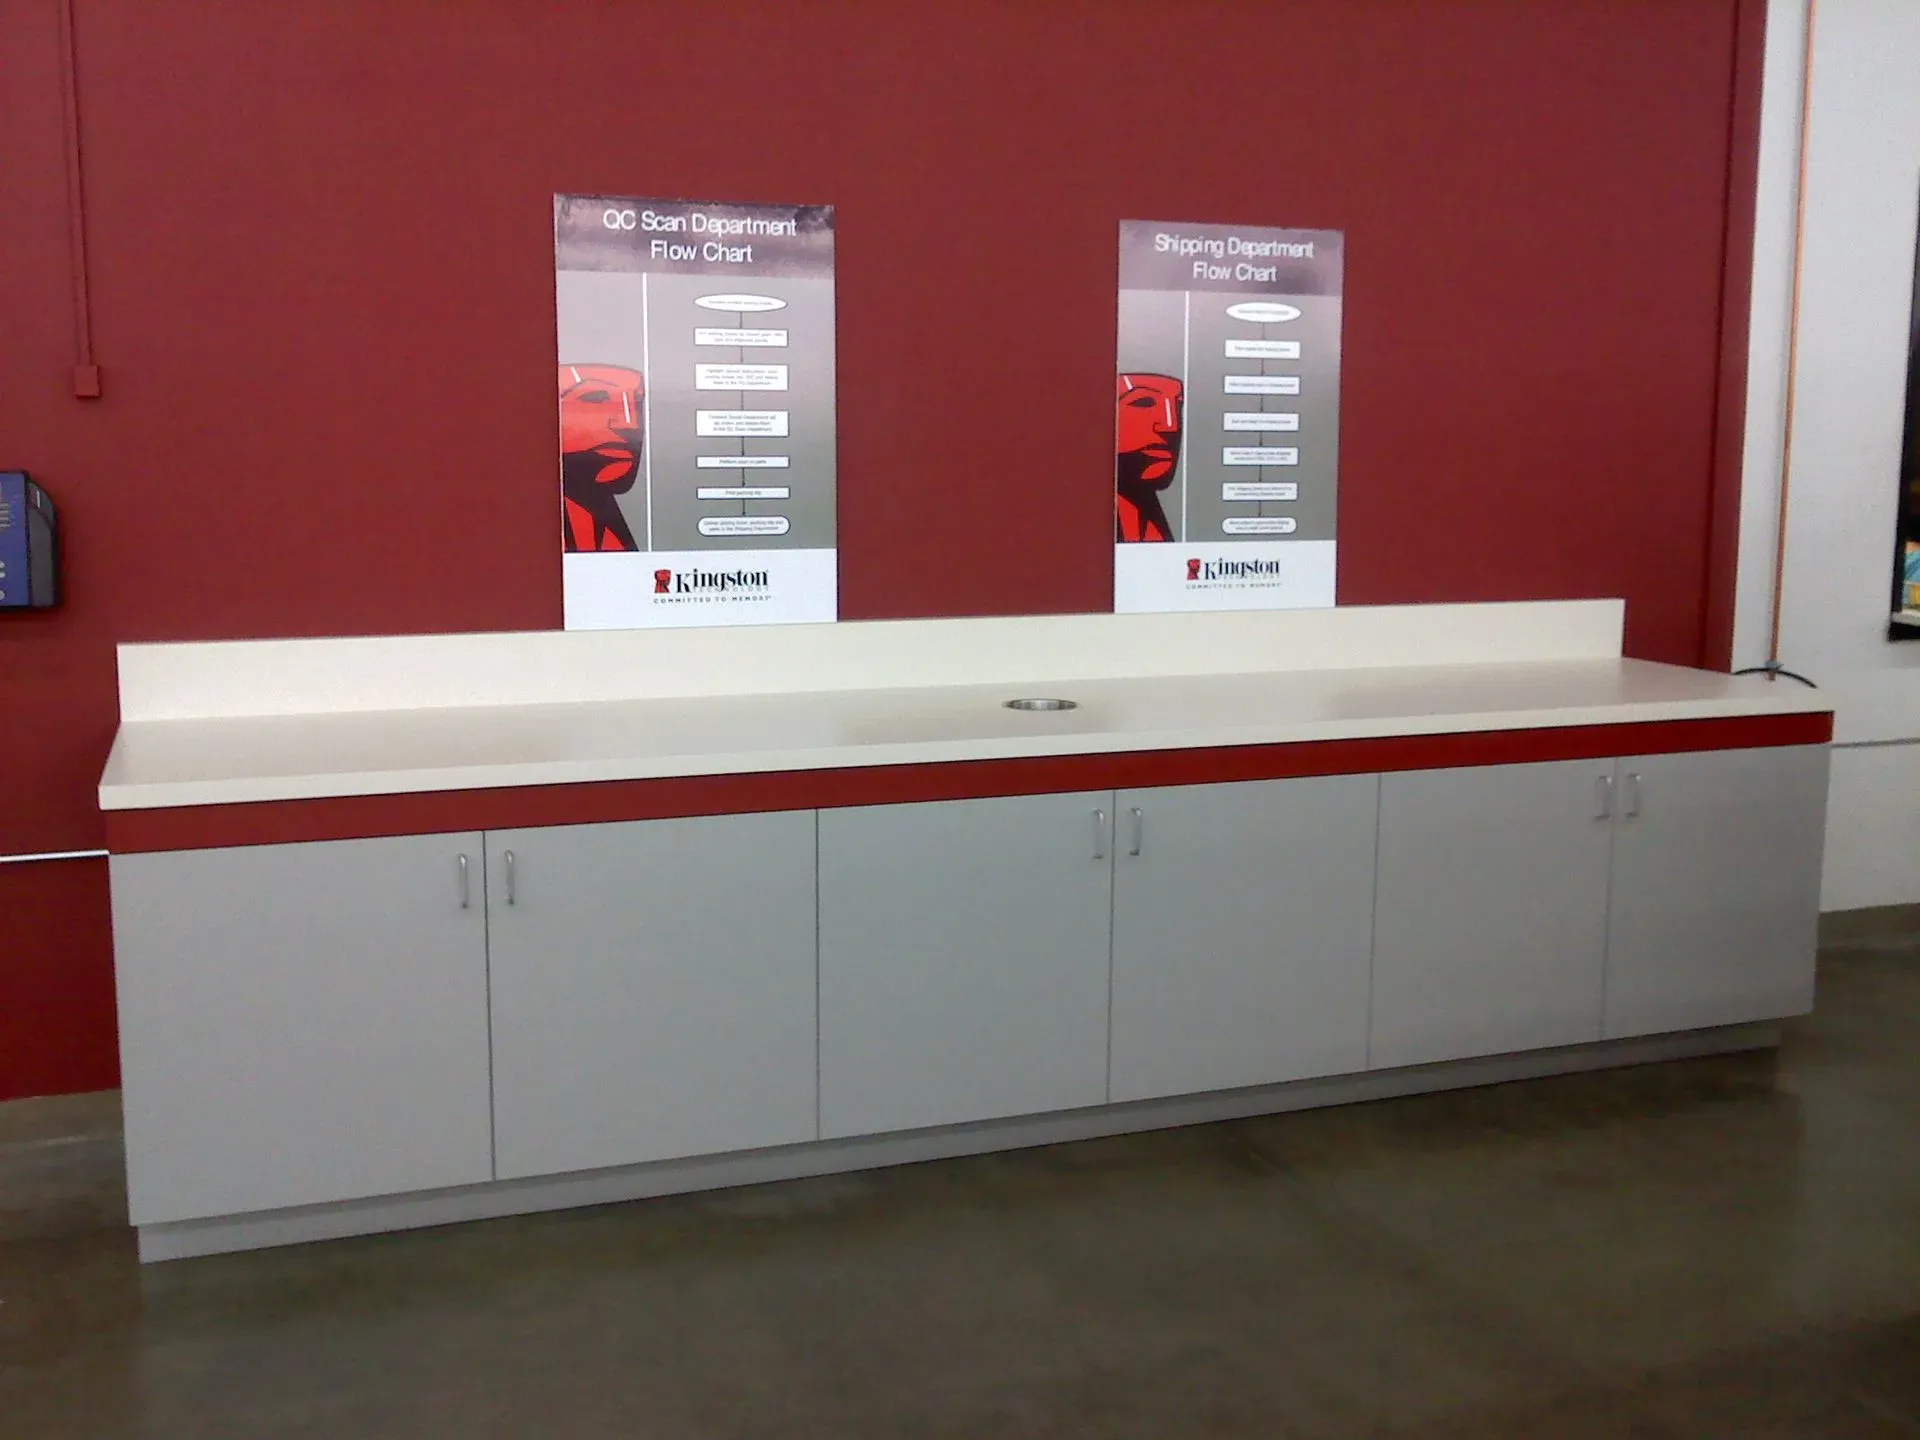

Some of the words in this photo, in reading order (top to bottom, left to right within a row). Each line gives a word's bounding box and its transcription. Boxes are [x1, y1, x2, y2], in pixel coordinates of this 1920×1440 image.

[603, 209, 636, 230] QC
[641, 211, 687, 232] Scan
[691, 213, 797, 237] Department
[650, 240, 698, 261] Flow
[702, 241, 753, 263] Chart
[1155, 233, 1225, 258] Shipping
[1227, 236, 1315, 259] Department
[1192, 261, 1232, 280] Flow
[1235, 263, 1277, 282] Chart
[675, 568, 768, 593] Kingston
[1204, 557, 1279, 580] Kingston
